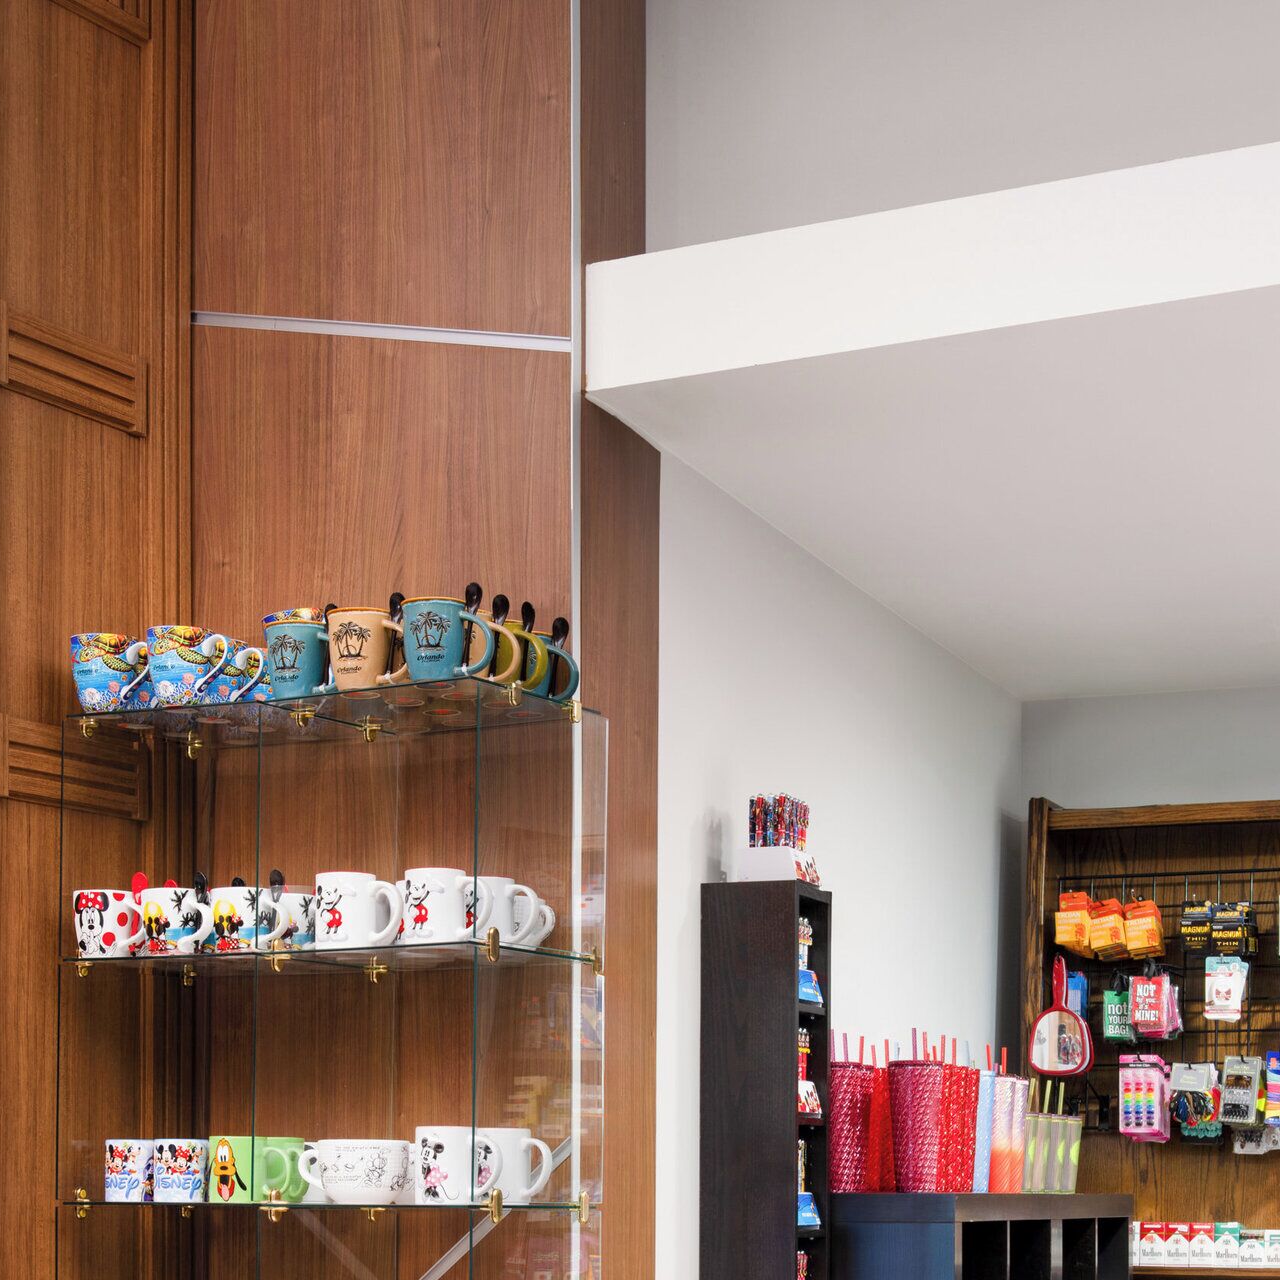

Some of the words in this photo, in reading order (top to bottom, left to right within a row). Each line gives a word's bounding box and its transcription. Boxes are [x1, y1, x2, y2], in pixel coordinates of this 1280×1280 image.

[417, 653, 445, 661] Orlando
[274, 674, 299, 682] Orlando
[1182, 925, 1210, 933] MAGNUM
[1212, 930, 1241, 938] MAGNUM
[1137, 985, 1156, 996] NOT
[1108, 1004, 1128, 1015] not
[1135, 1010, 1158, 1020] MINE!
[1108, 1025, 1129, 1035] BAG!
[1142, 1248, 1162, 1258] Marlboro
[1167, 1248, 1187, 1257] Marlboro
[1191, 1248, 1212, 1257] Marlboro
[1216, 1249, 1238, 1259] Marlboro
[1241, 1253, 1262, 1263] Marlboro
